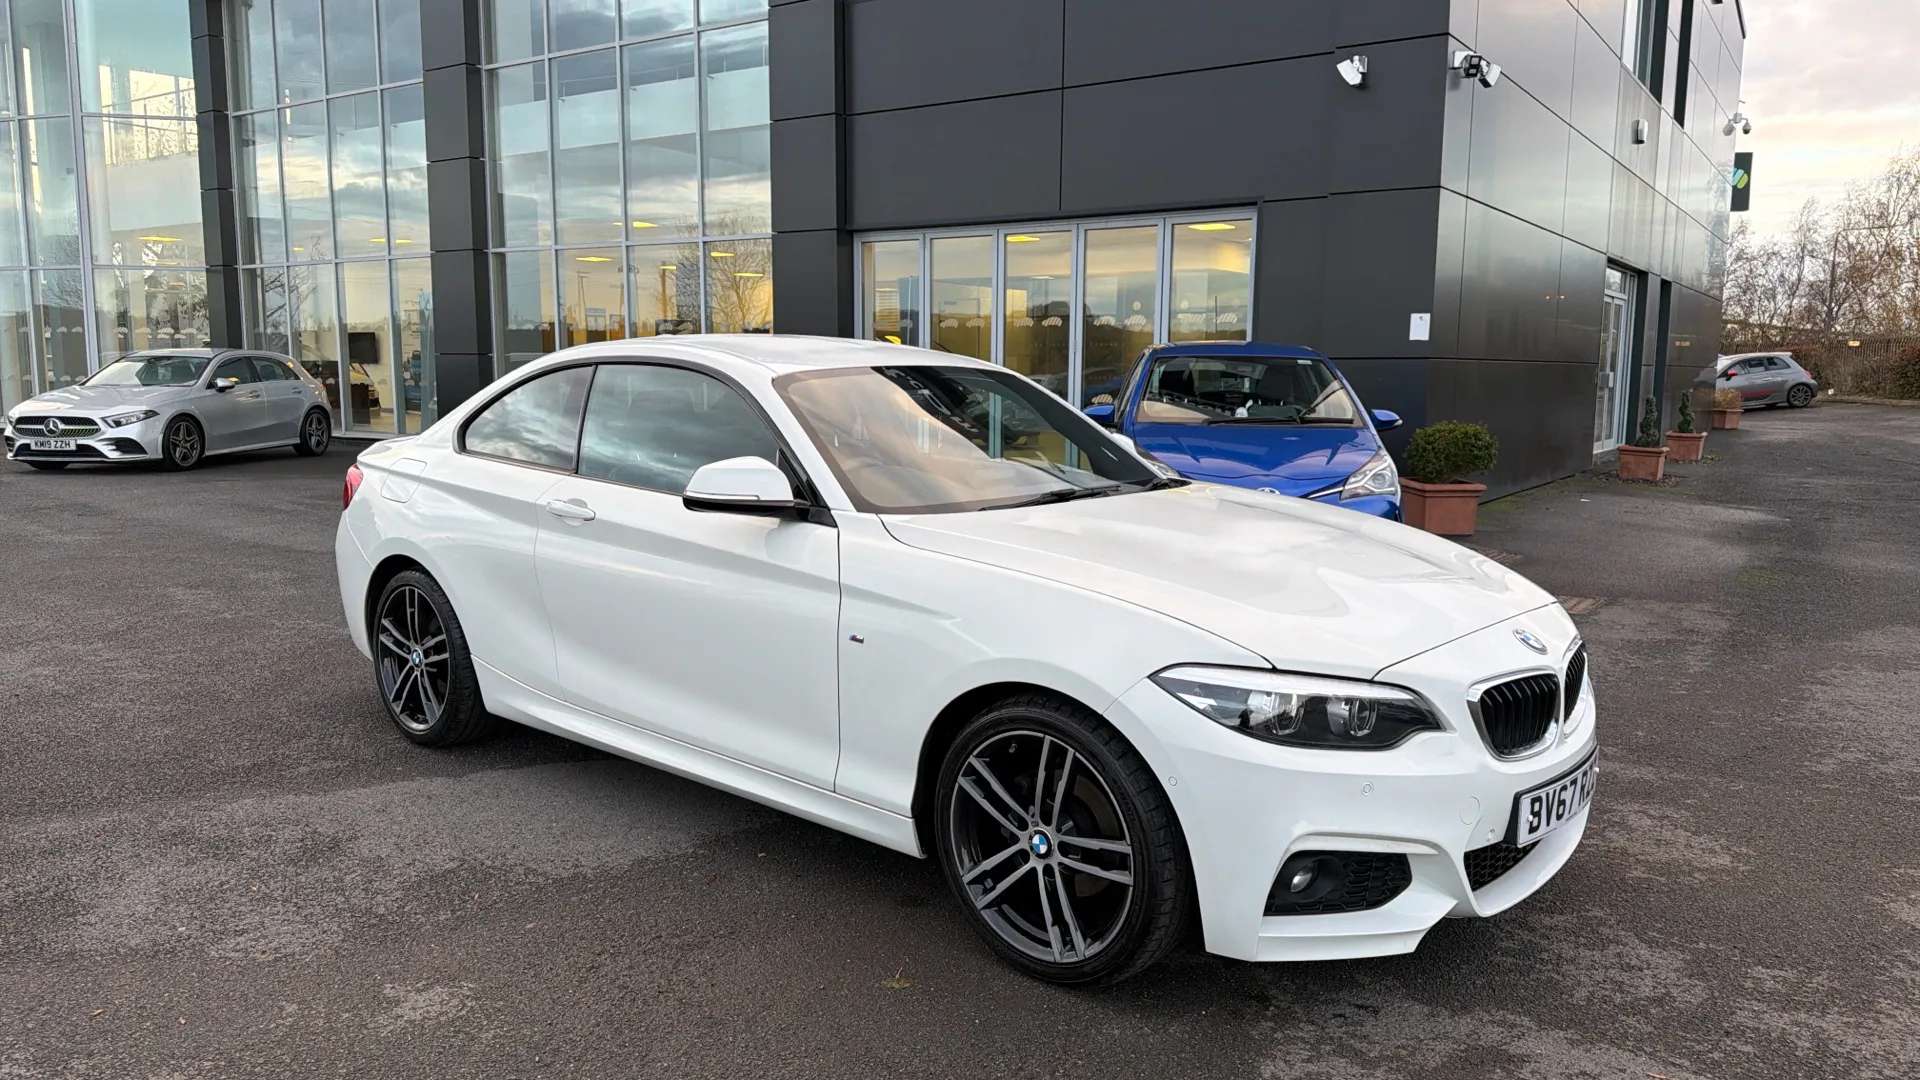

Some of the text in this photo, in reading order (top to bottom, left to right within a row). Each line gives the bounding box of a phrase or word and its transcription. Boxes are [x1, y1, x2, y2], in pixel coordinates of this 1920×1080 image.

[34, 440, 71, 449] KM19 ZZH
[1527, 776, 1578, 835] BV67
